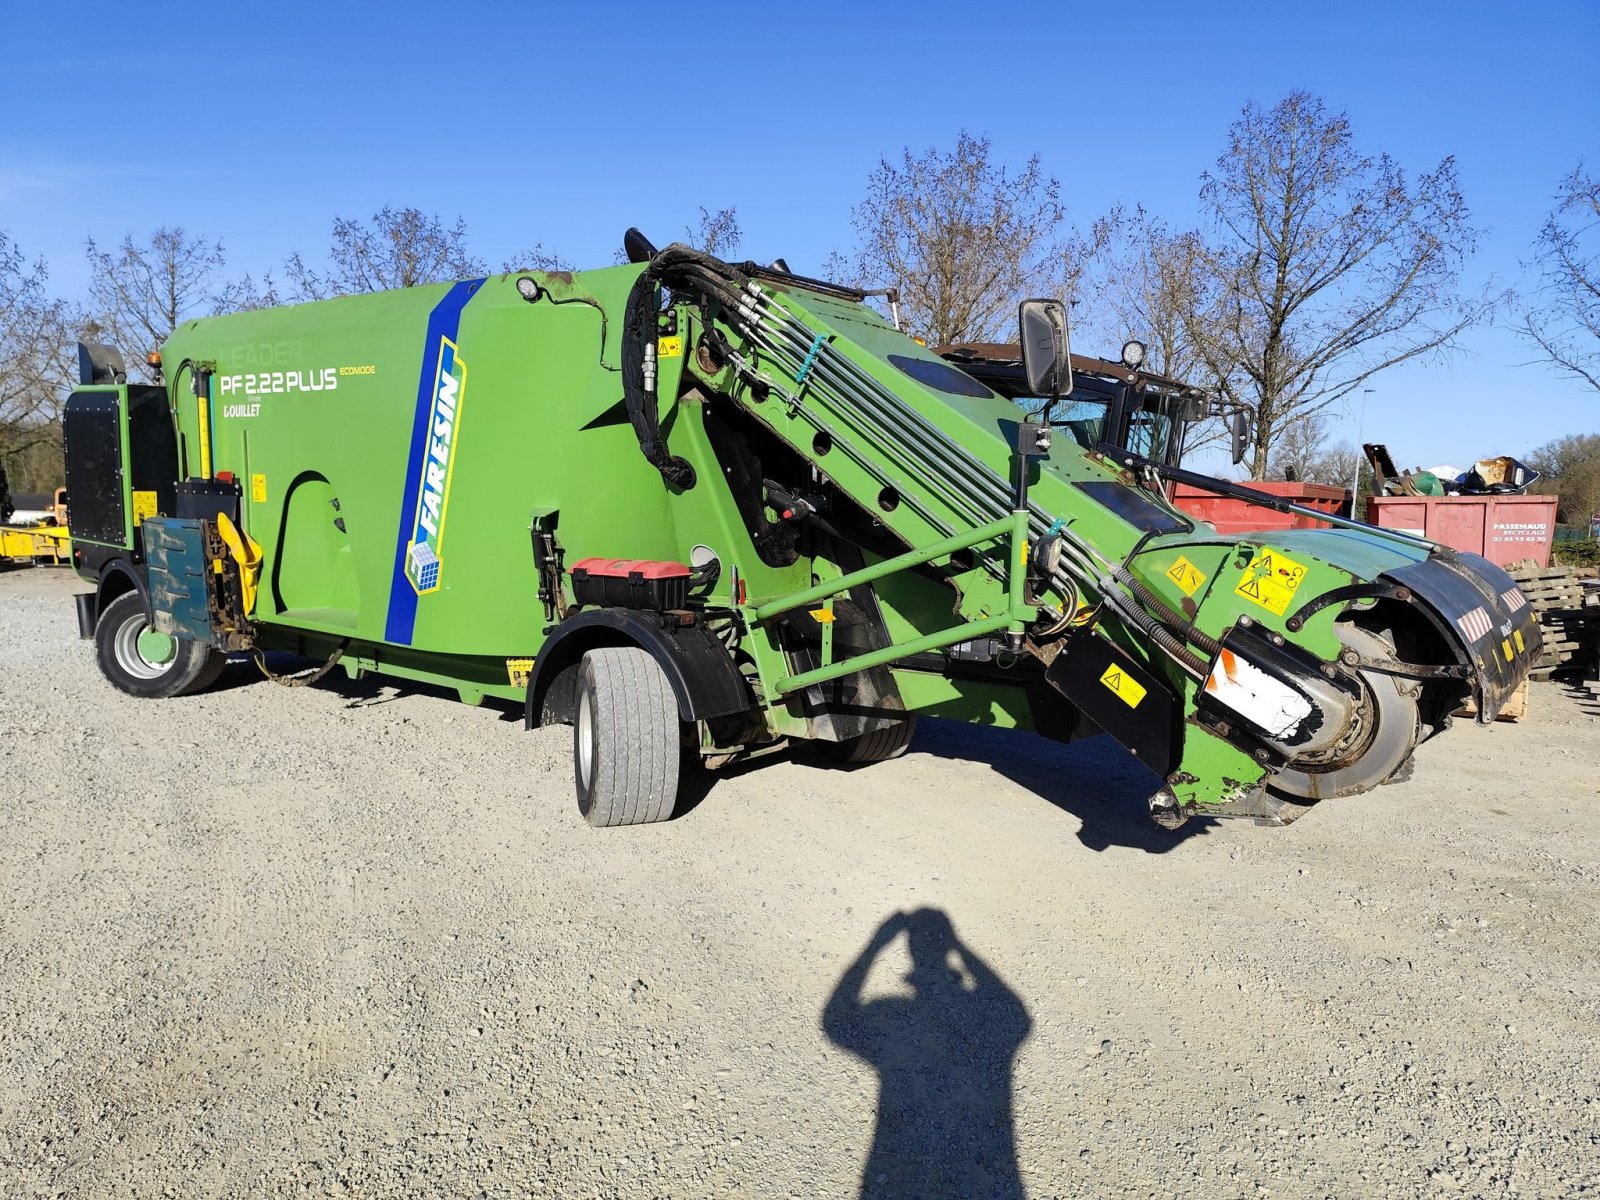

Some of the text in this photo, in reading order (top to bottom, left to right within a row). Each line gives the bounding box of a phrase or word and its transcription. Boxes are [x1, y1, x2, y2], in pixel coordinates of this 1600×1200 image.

[220, 368, 337, 395] PF 2.22 PLUS
[339, 365, 375, 376] ECOMODE
[420, 368, 458, 538] FARESIN
